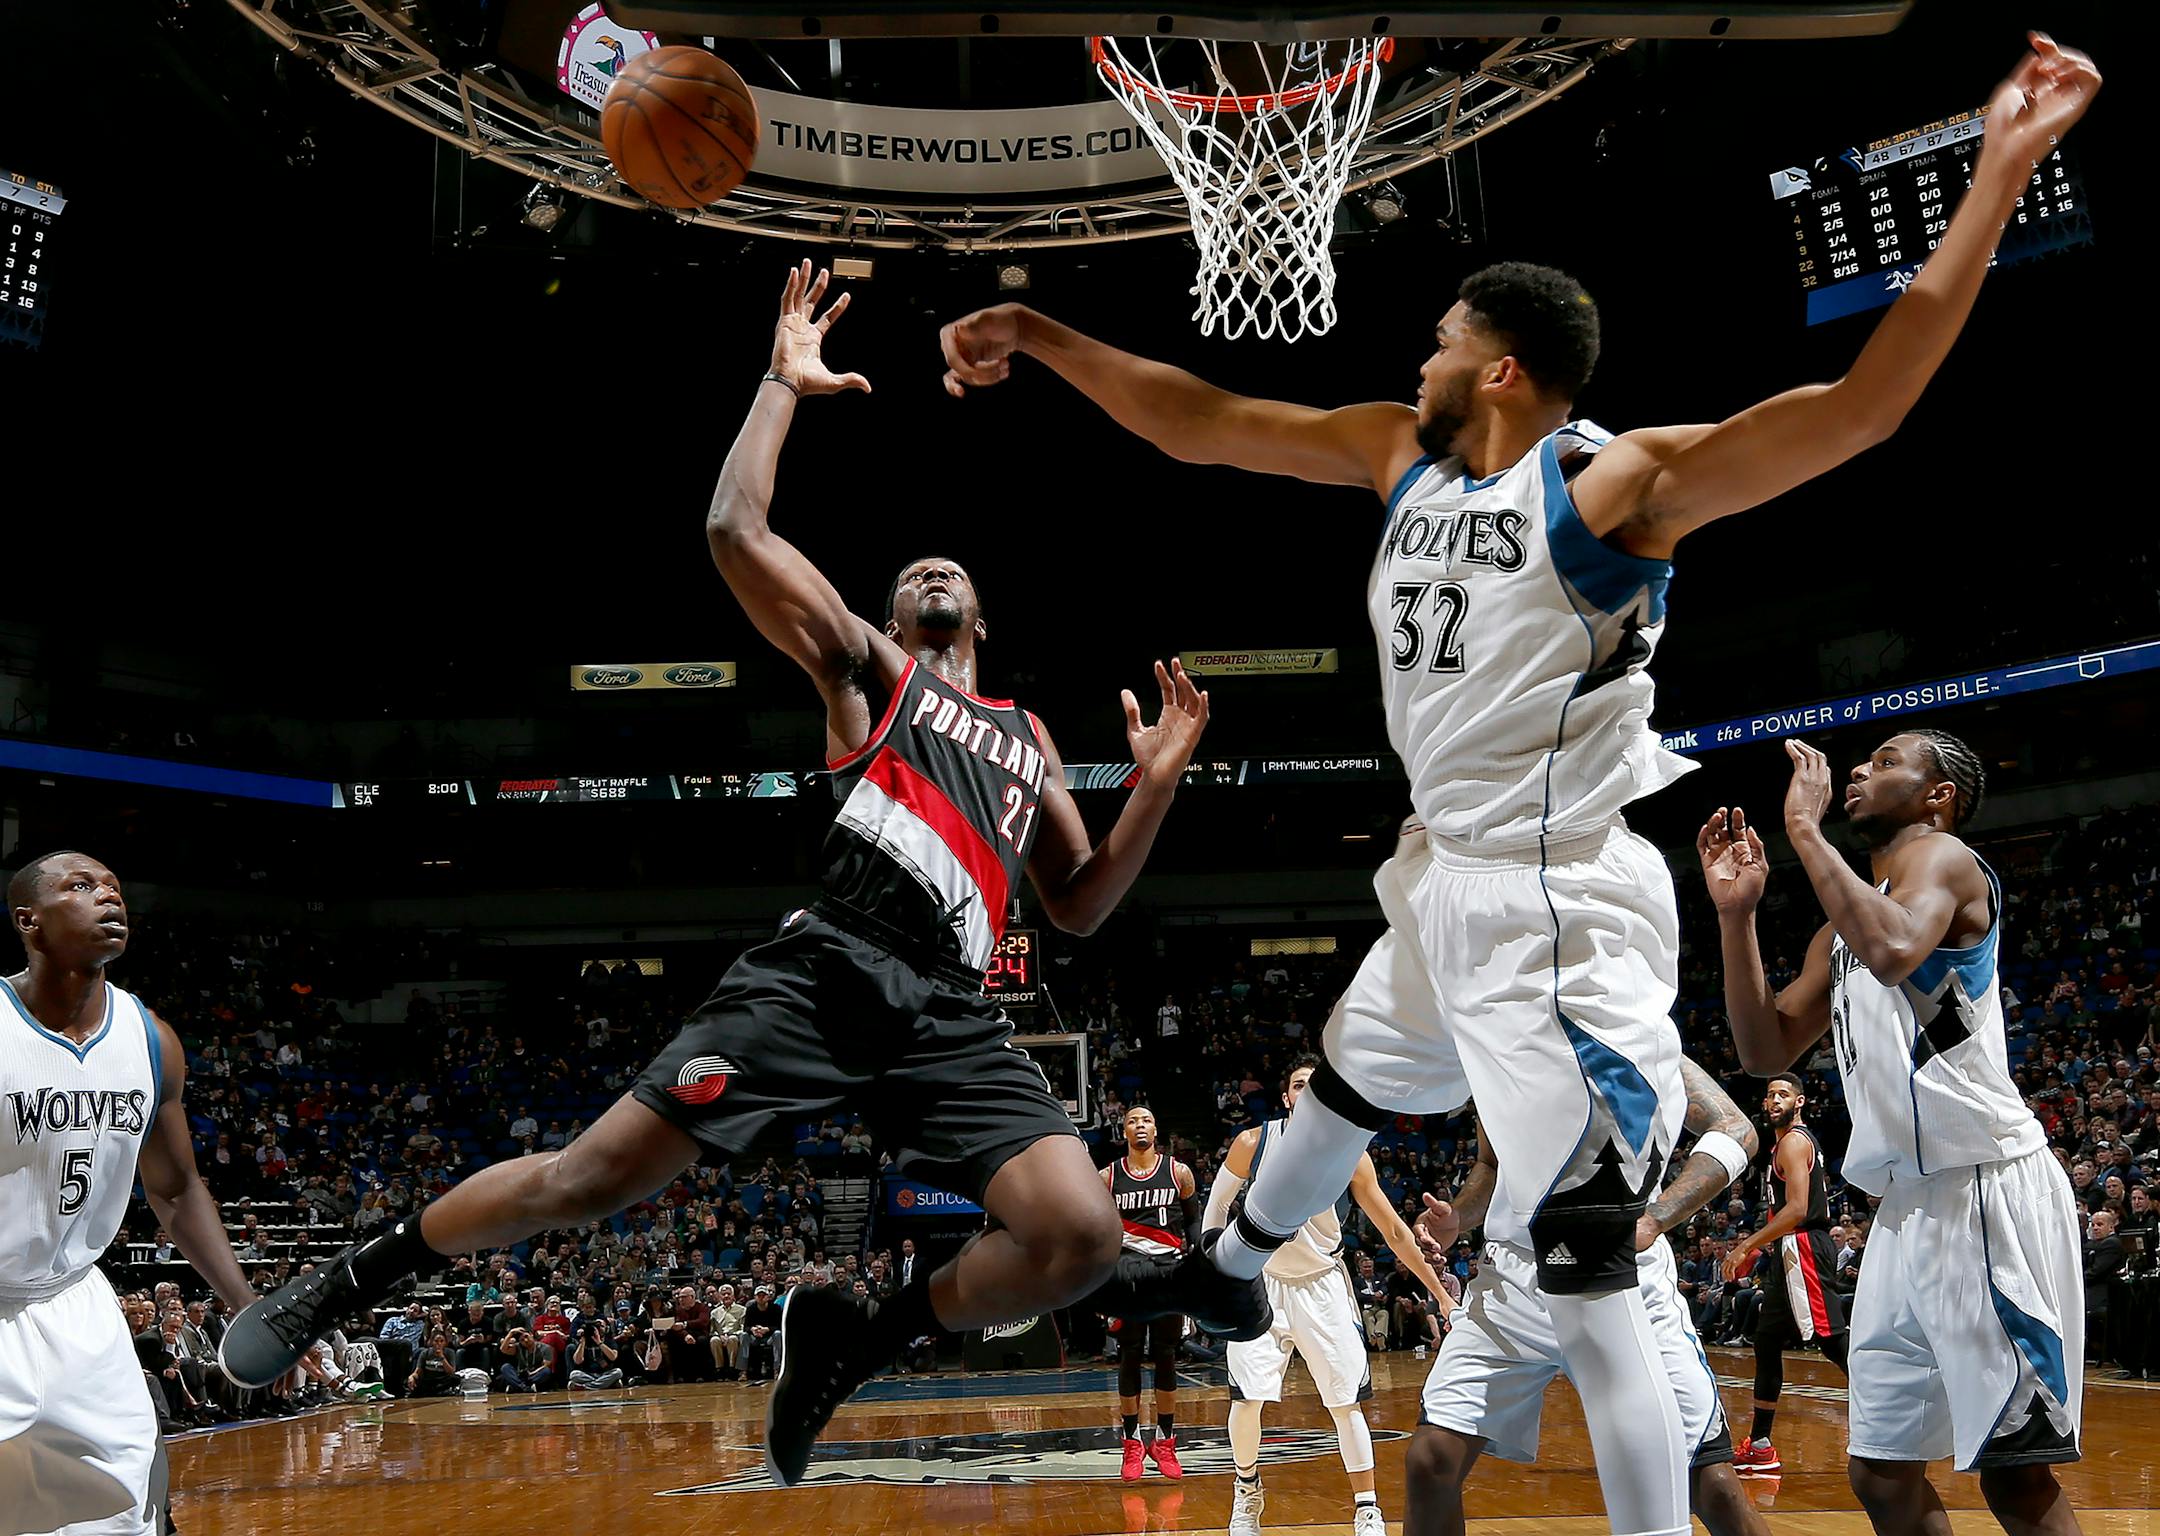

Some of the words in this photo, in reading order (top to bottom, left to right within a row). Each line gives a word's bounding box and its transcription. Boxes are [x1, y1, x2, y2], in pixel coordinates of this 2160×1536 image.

[1869, 138, 1891, 151] FG%
[1922, 119, 1945, 135] FT%
[1948, 111, 1970, 126] REB
[1871, 150, 1890, 165] 48
[1926, 133, 1943, 147] 87
[1952, 124, 1971, 138] 25
[11, 173, 26, 185] TO
[36, 181, 57, 195] STL
[11, 186, 21, 197] 7
[39, 196, 49, 207] 2
[1821, 202, 1842, 219] 3/5
[1870, 187, 1889, 201] 1/2
[1917, 172, 1938, 186] 2/2
[1963, 162, 1970, 172] 1
[1823, 218, 1845, 235] 2/5
[1871, 203, 1893, 220] 0/0
[1920, 188, 1942, 205] 0/0
[2052, 151, 2061, 160] 4
[1829, 234, 1847, 247] 1/4
[1874, 219, 1895, 232] 0/0
[1923, 204, 1945, 221] 6/7
[2033, 174, 2041, 184] 3
[2055, 168, 2063, 178] 8
[12, 225, 21, 235] 0
[35, 232, 43, 242] 9
[1830, 248, 1857, 266] 7/14
[1877, 235, 1898, 248] 3/3
[1926, 220, 1950, 237] 2/2
[2016, 196, 2026, 208] 3
[2037, 191, 2044, 201] 1
[2054, 183, 2070, 196] 19
[1834, 263, 1859, 278] 8/16
[1880, 251, 1901, 264] 0/0
[1926, 236, 1944, 252] 0/
[2040, 207, 2049, 217] 2
[2058, 199, 2073, 212] 16
[10, 242, 16, 252] 1
[32, 249, 40, 258] 4
[6, 257, 14, 268] 3
[28, 264, 37, 275] 8
[4, 275, 10, 284] 1
[21, 280, 37, 292] 19
[0, 291, 9, 301] 2
[18, 297, 34, 308] 16
[1391, 581, 1470, 674] 32
[594, 668, 630, 684] Ford
[675, 667, 712, 683] Ford
[1660, 729, 1700, 751] ank
[1718, 726, 1741, 741] the
[1752, 706, 1834, 736] POWER
[1844, 701, 1862, 720] of
[354, 785, 380, 796] CLE
[429, 783, 458, 793] 8:00
[578, 778, 607, 788] SPLIT
[609, 777, 648, 787] RAFFLE
[722, 775, 741, 783] TOL
[1184, 762, 1203, 772] uls
[1269, 761, 1320, 770] RHYTHMIC
[1323, 759, 1372, 769] CLAPPING
[355, 794, 372, 805] SA
[694, 788, 700, 797] 2
[726, 787, 741, 796] 3+
[1186, 776, 1192, 784] 4
[1216, 775, 1231, 783] 4+
[998, 783, 1037, 856] 21
[986, 957, 1025, 987] 24
[992, 992, 1036, 1003] TISSOT
[6, 1086, 147, 1145] WOLVES
[59, 1148, 95, 1215] 5
[916, 1191, 945, 1206] sun
[1115, 1187, 1176, 1210] PORTLAND
[1545, 1257, 1578, 1265] adidas
